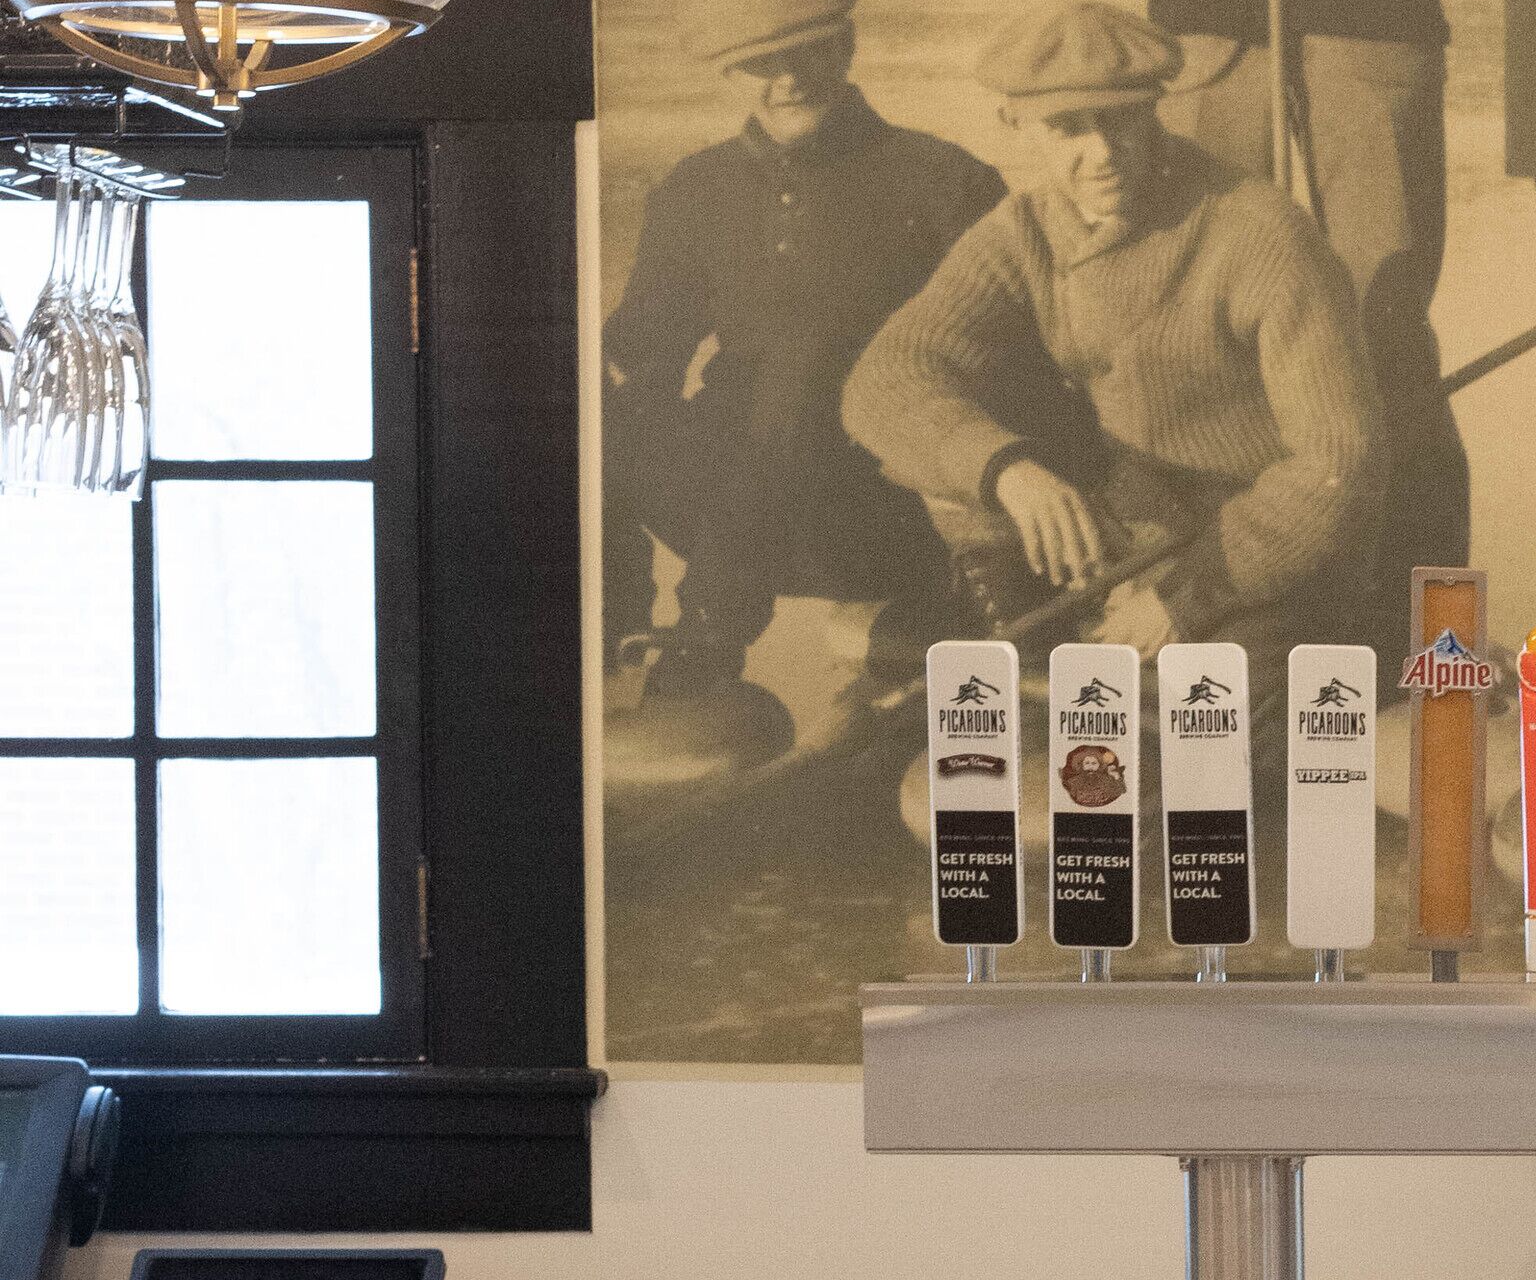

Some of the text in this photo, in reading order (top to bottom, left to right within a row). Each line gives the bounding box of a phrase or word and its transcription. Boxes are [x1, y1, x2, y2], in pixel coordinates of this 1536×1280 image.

[1404, 650, 1491, 694] Alpine
[939, 709, 1006, 733] PICAROONS
[1060, 711, 1126, 736] PICAROONS
[1171, 708, 1237, 733] PICAROONS
[1299, 710, 1366, 736] PICAROONS
[1296, 769, 1349, 783] YIPPEE
[940, 853, 1013, 866] GET FRESH
[1056, 855, 1130, 868] GET FRESH
[1172, 853, 1245, 865] GET FRESH
[941, 870, 990, 882] WITH A
[1056, 871, 1106, 884] WITH A
[1172, 870, 1222, 882] WITH A
[941, 887, 990, 899] LOCAL.
[1056, 888, 1105, 901] LOCAL.
[1173, 887, 1222, 899] LOCAL.
